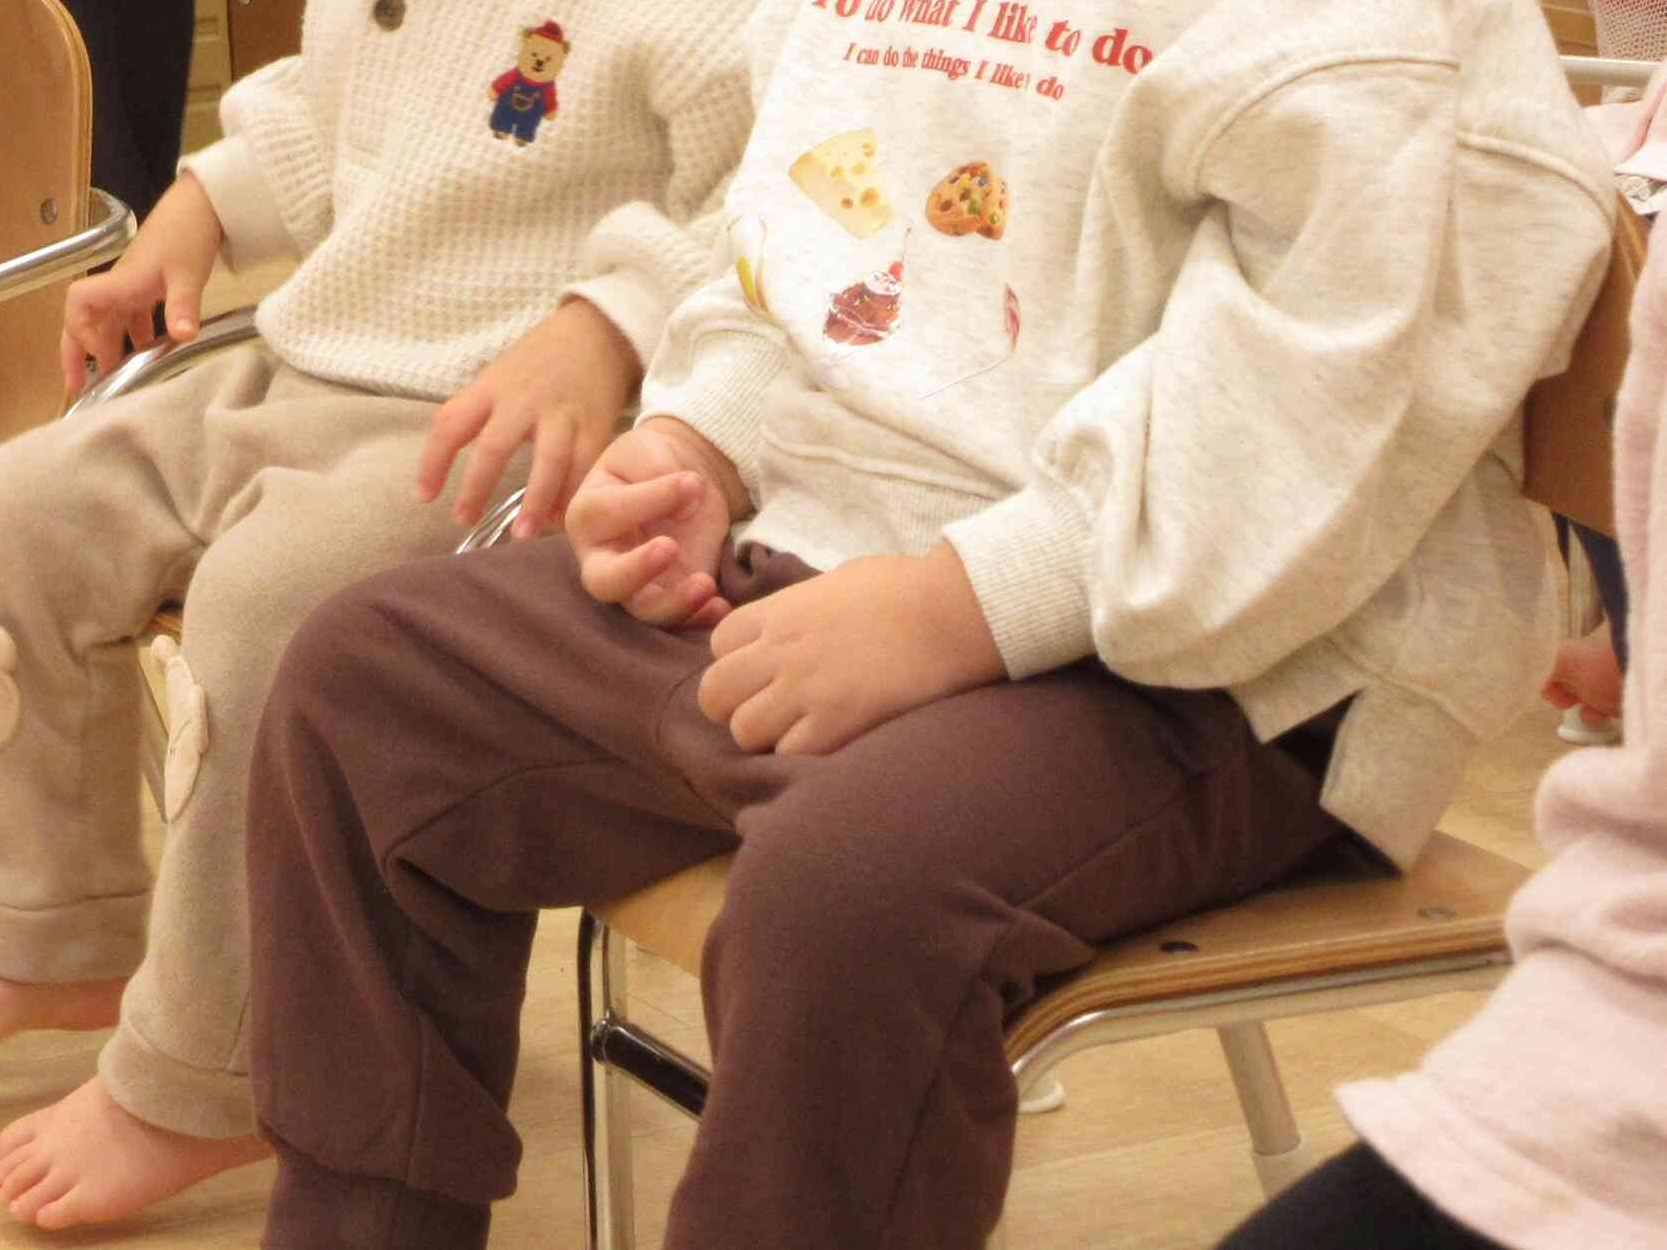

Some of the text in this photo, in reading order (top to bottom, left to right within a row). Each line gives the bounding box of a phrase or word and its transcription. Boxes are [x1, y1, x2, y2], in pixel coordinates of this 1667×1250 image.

[843, 42, 857, 62] I
[857, 48, 879, 66] can
[883, 46, 899, 68] do
[902, 46, 919, 68] the
[921, 48, 972, 81] things
[974, 60, 990, 80] I
[990, 62, 1024, 90] like
[1036, 76, 1065, 102] do
[988, 1, 1038, 44] like
[1045, 18, 1082, 57] to
[1092, 28, 1154, 76] do
